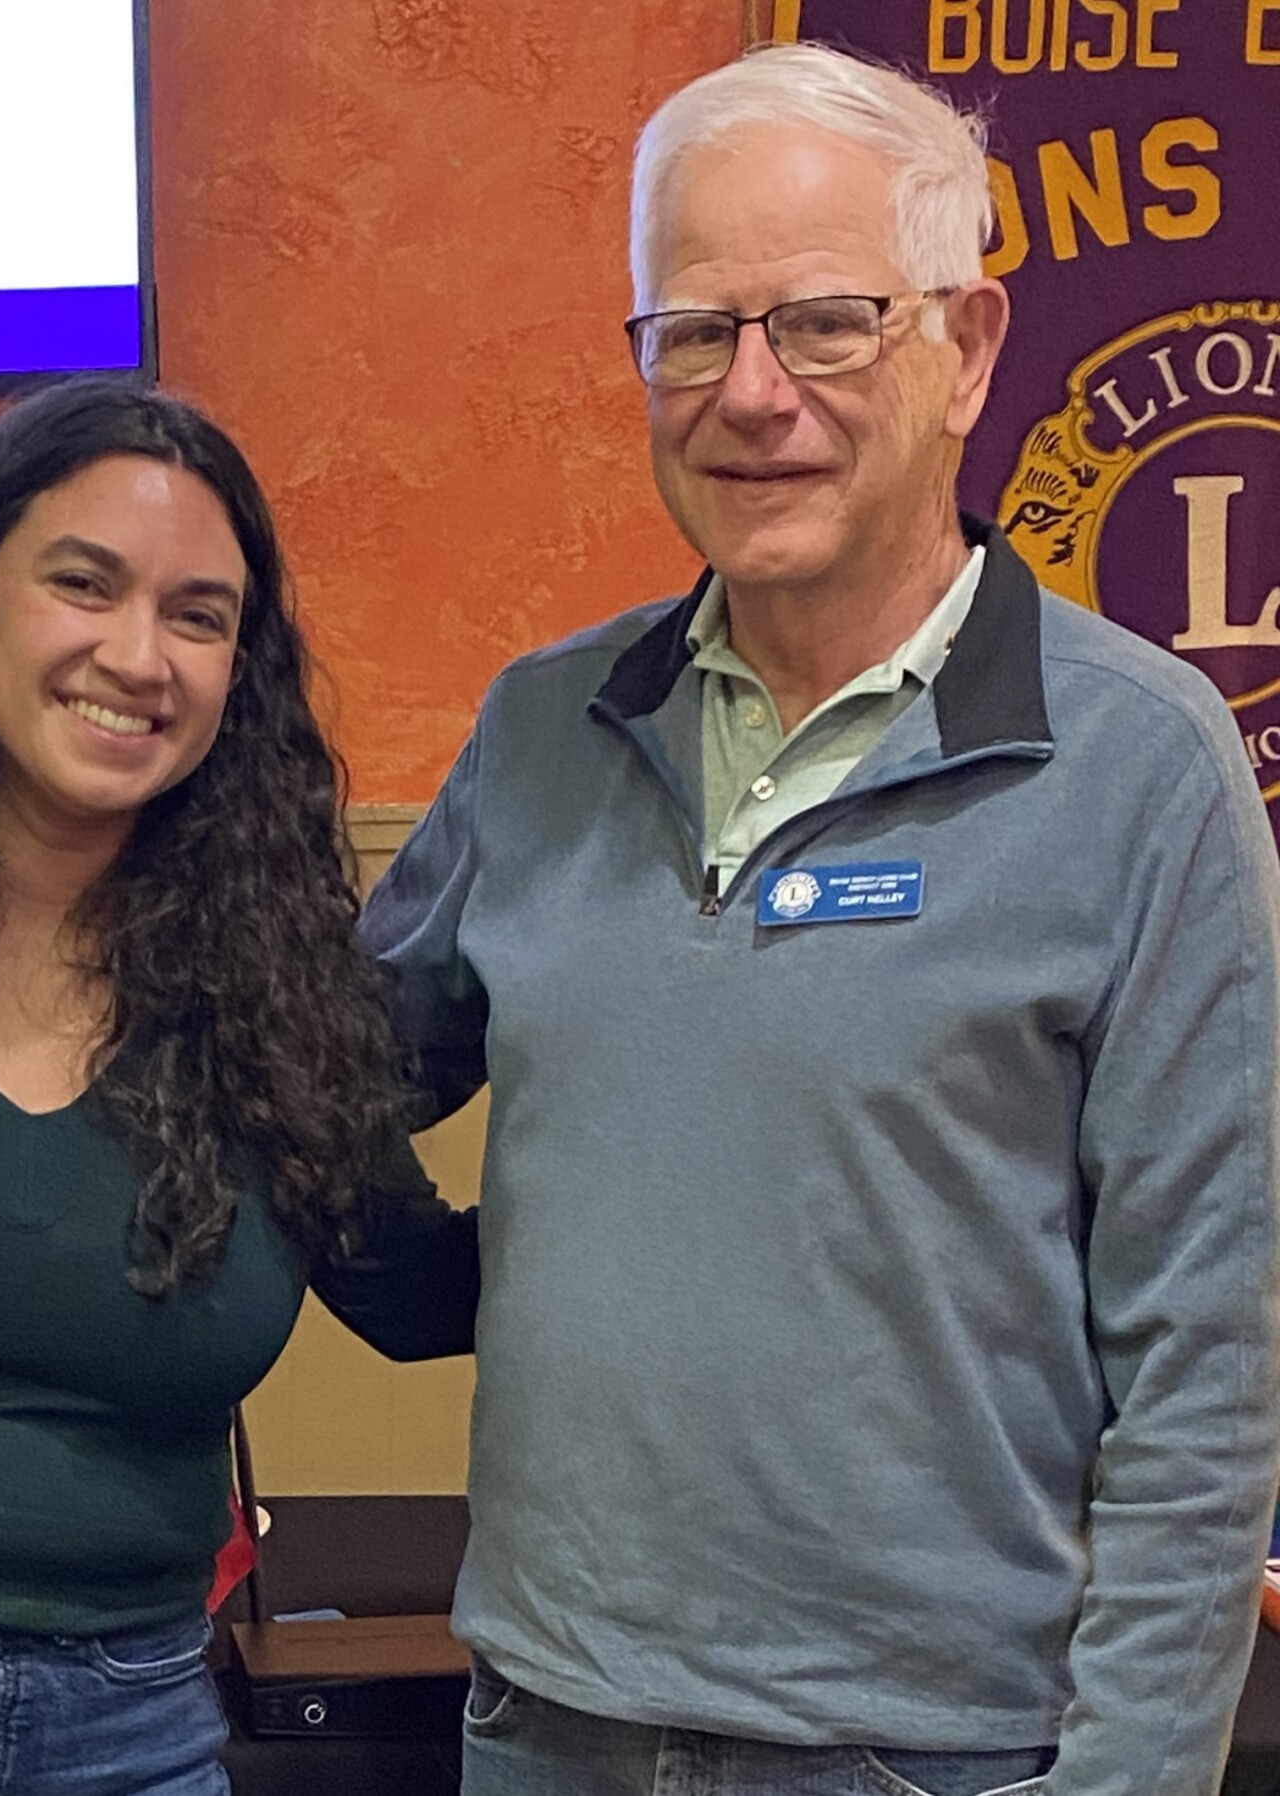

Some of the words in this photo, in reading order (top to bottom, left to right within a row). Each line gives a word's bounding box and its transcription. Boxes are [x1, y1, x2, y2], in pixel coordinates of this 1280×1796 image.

[928, 0, 1179, 74] BOISE
[982, 117, 1221, 278] ONS
[1172, 475, 1280, 650] L
